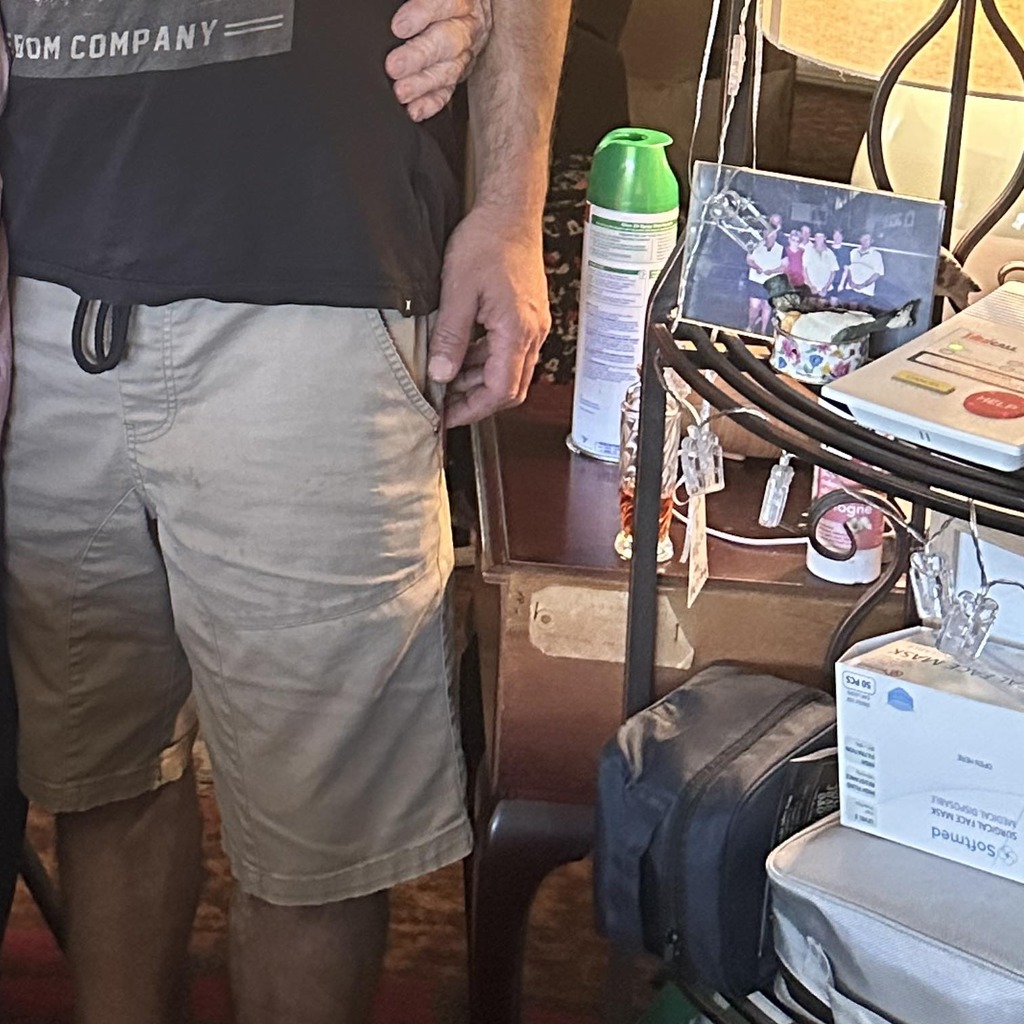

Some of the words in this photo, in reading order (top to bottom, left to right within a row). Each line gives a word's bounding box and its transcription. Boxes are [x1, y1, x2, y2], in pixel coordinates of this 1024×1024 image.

[70, 19, 219, 60] COMPANY
[976, 395, 1019, 410] HELP
[889, 647, 946, 666] MASK
[845, 675, 861, 687] PCS
[862, 679, 872, 690] 50
[956, 753, 975, 765] HERE
[975, 759, 993, 771] OPEN
[930, 795, 979, 817] DISPOSABLE
[930, 807, 955, 823] MASK
[956, 813, 977, 828] FACE
[979, 808, 1017, 829] MEDICAL
[977, 820, 1018, 841] SURGICAL
[931, 826, 996, 858] Softmed
